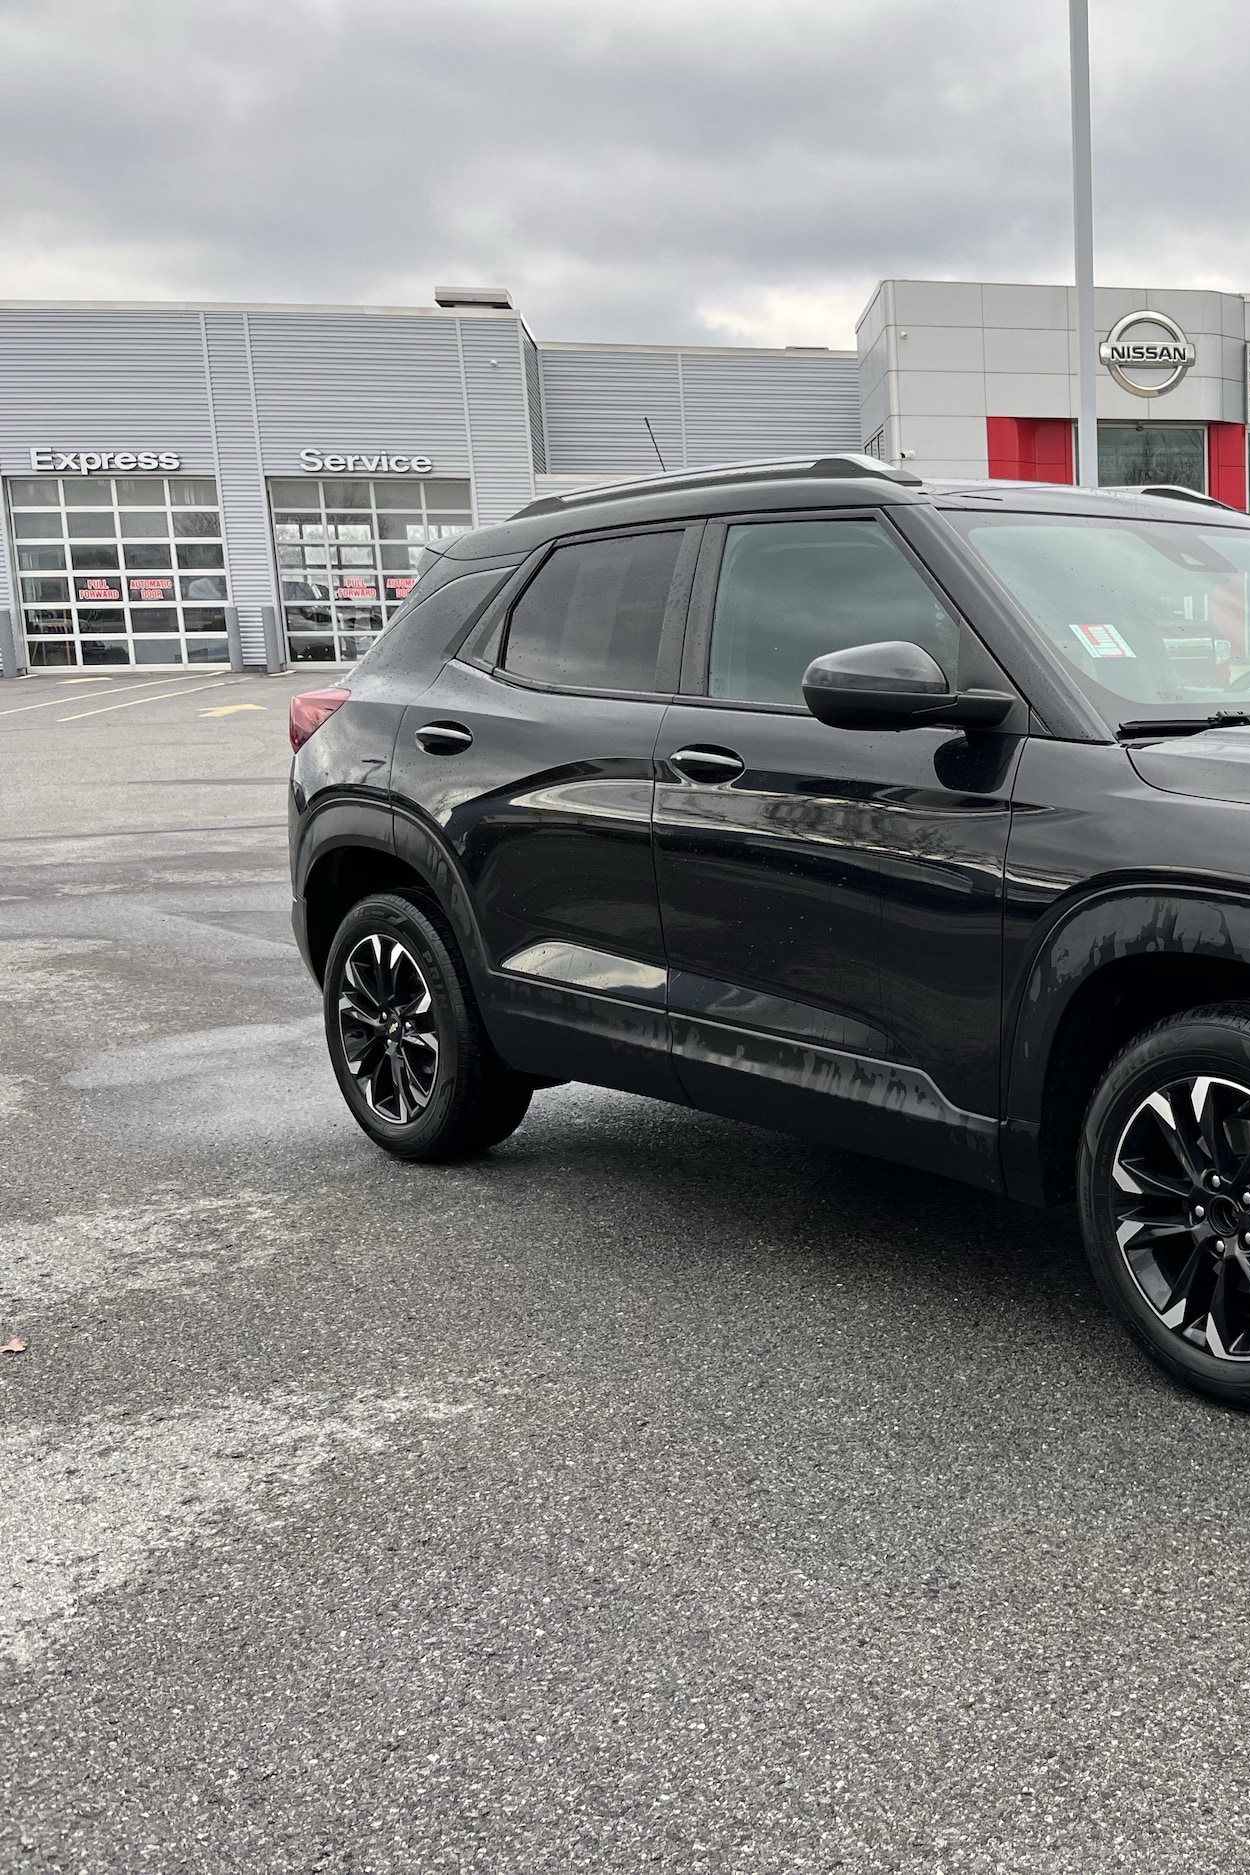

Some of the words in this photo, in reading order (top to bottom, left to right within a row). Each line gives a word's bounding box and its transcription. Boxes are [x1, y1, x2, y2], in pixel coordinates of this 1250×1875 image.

[1111, 346, 1187, 361] NISSAN
[29, 447, 181, 476] Express
[299, 448, 433, 473] Service
[87, 579, 109, 590] PULL
[129, 579, 172, 590] AUTOMATIC
[345, 579, 366, 588] PULL
[386, 578, 415, 588] AUTOM
[78, 589, 119, 600] FORWARD
[141, 590, 163, 600] DOOR
[338, 588, 376, 598] FORWARD
